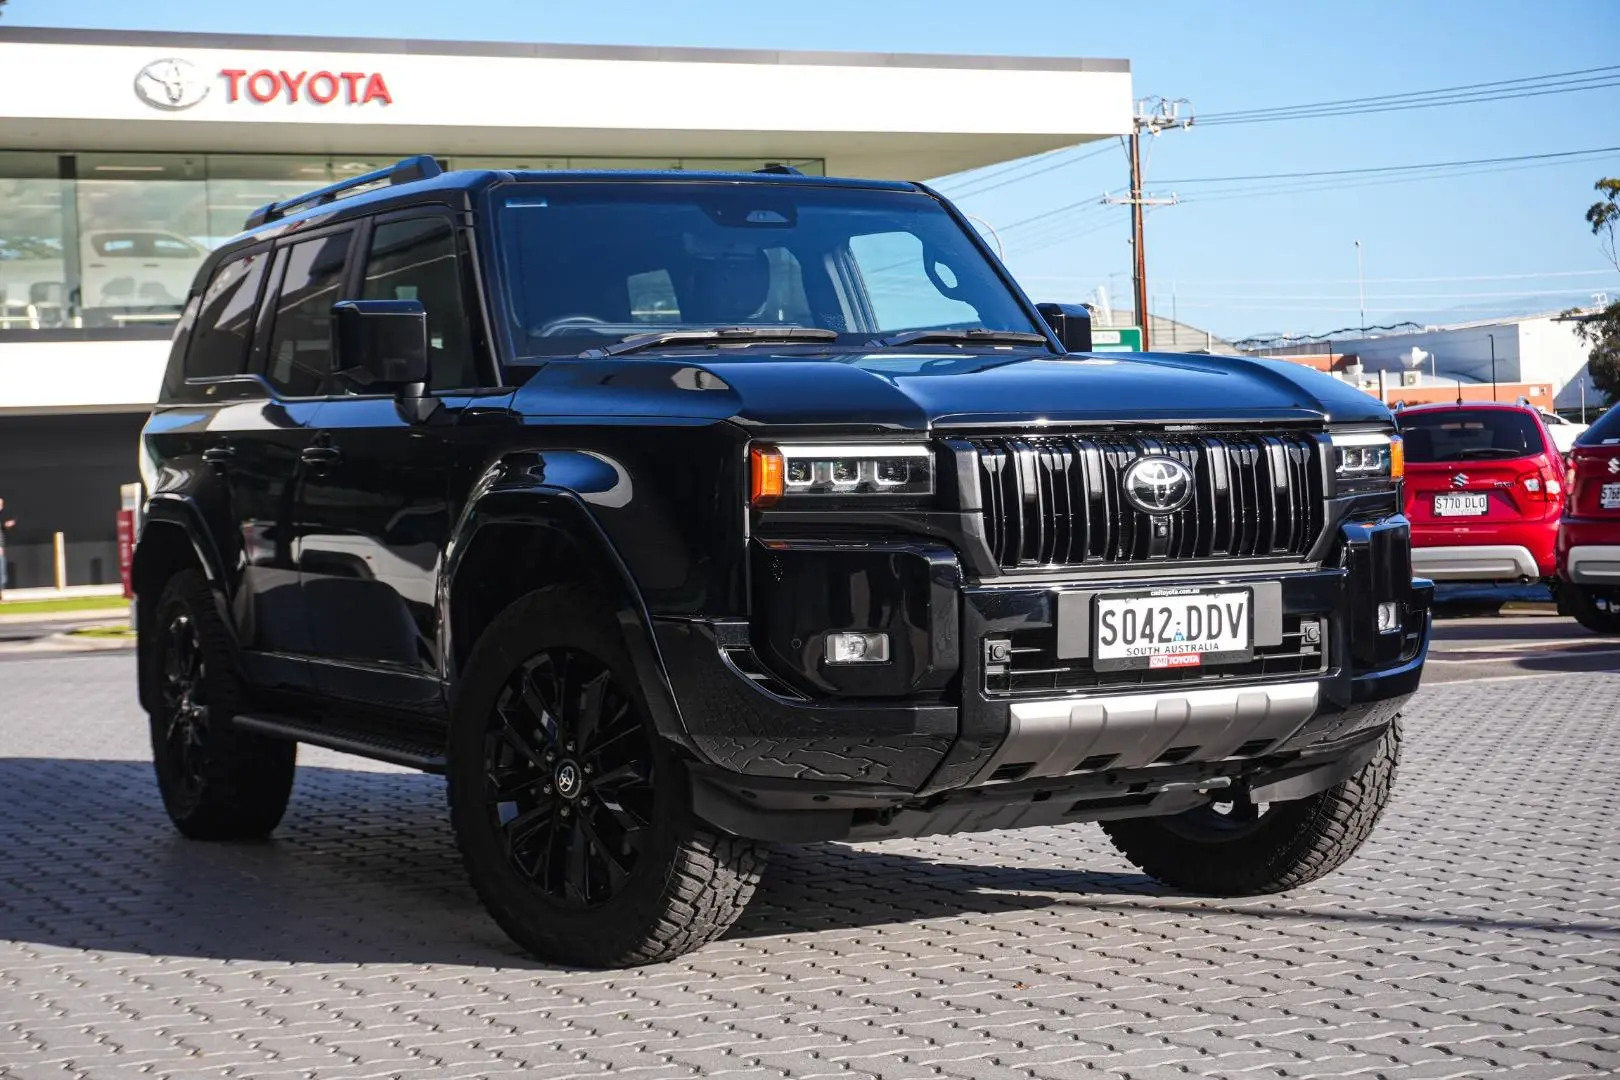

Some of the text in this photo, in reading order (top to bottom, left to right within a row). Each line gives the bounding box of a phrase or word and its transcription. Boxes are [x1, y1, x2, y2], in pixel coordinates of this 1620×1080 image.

[221, 69, 393, 104] TOYOTA
[1436, 498, 1461, 509] S770
[1101, 602, 1244, 646] S042 DDV
[1126, 642, 1219, 656] SOUTH AUSTRALIA
[1168, 655, 1199, 665] TOYOTA
